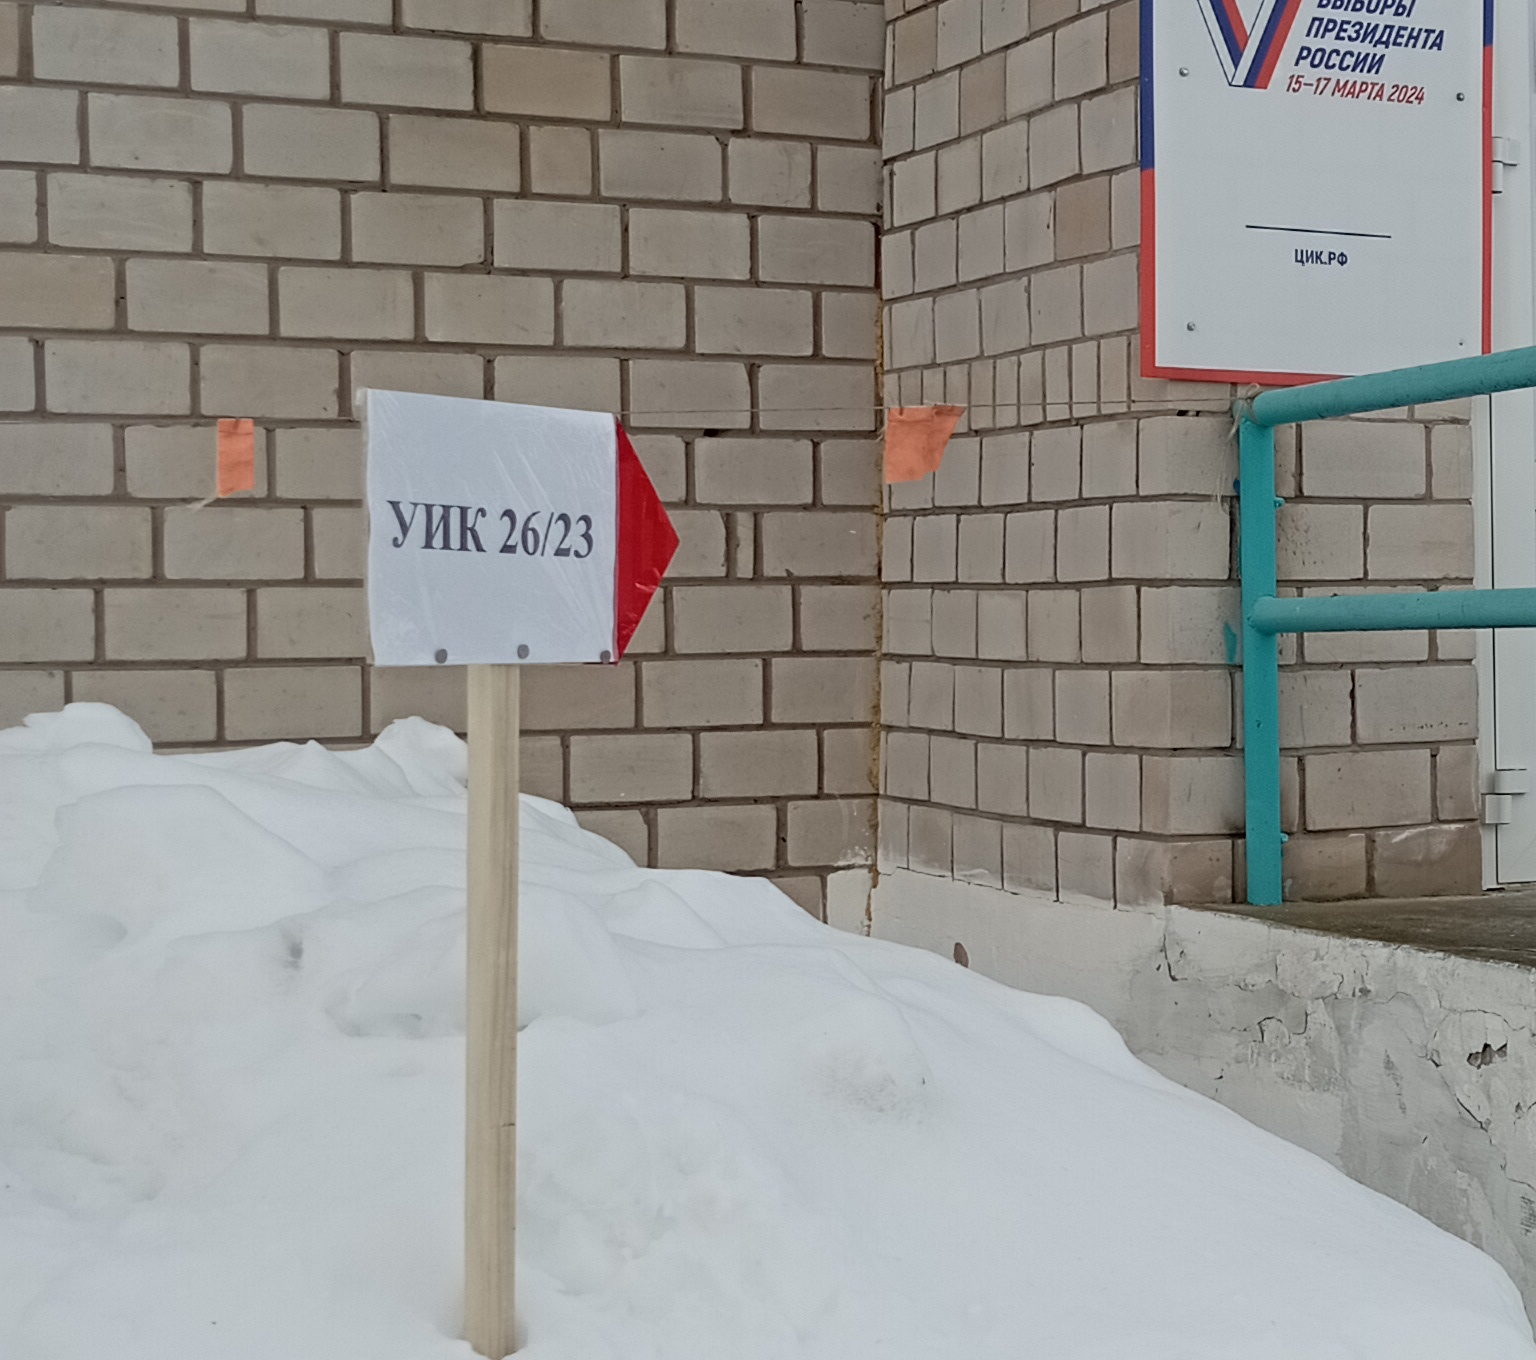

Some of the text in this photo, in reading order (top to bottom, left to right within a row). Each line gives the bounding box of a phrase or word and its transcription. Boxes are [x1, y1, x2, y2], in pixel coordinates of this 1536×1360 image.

[1305, 16, 1445, 51] ПРЕЗИДЕНТА
[1293, 45, 1387, 75] РОССИИ
[1331, 78, 1386, 102] МАРТА
[1387, 83, 1426, 105] 2024
[1294, 248, 1348, 267] ЦИК.РФ
[386, 500, 594, 559] УИК 26/23
